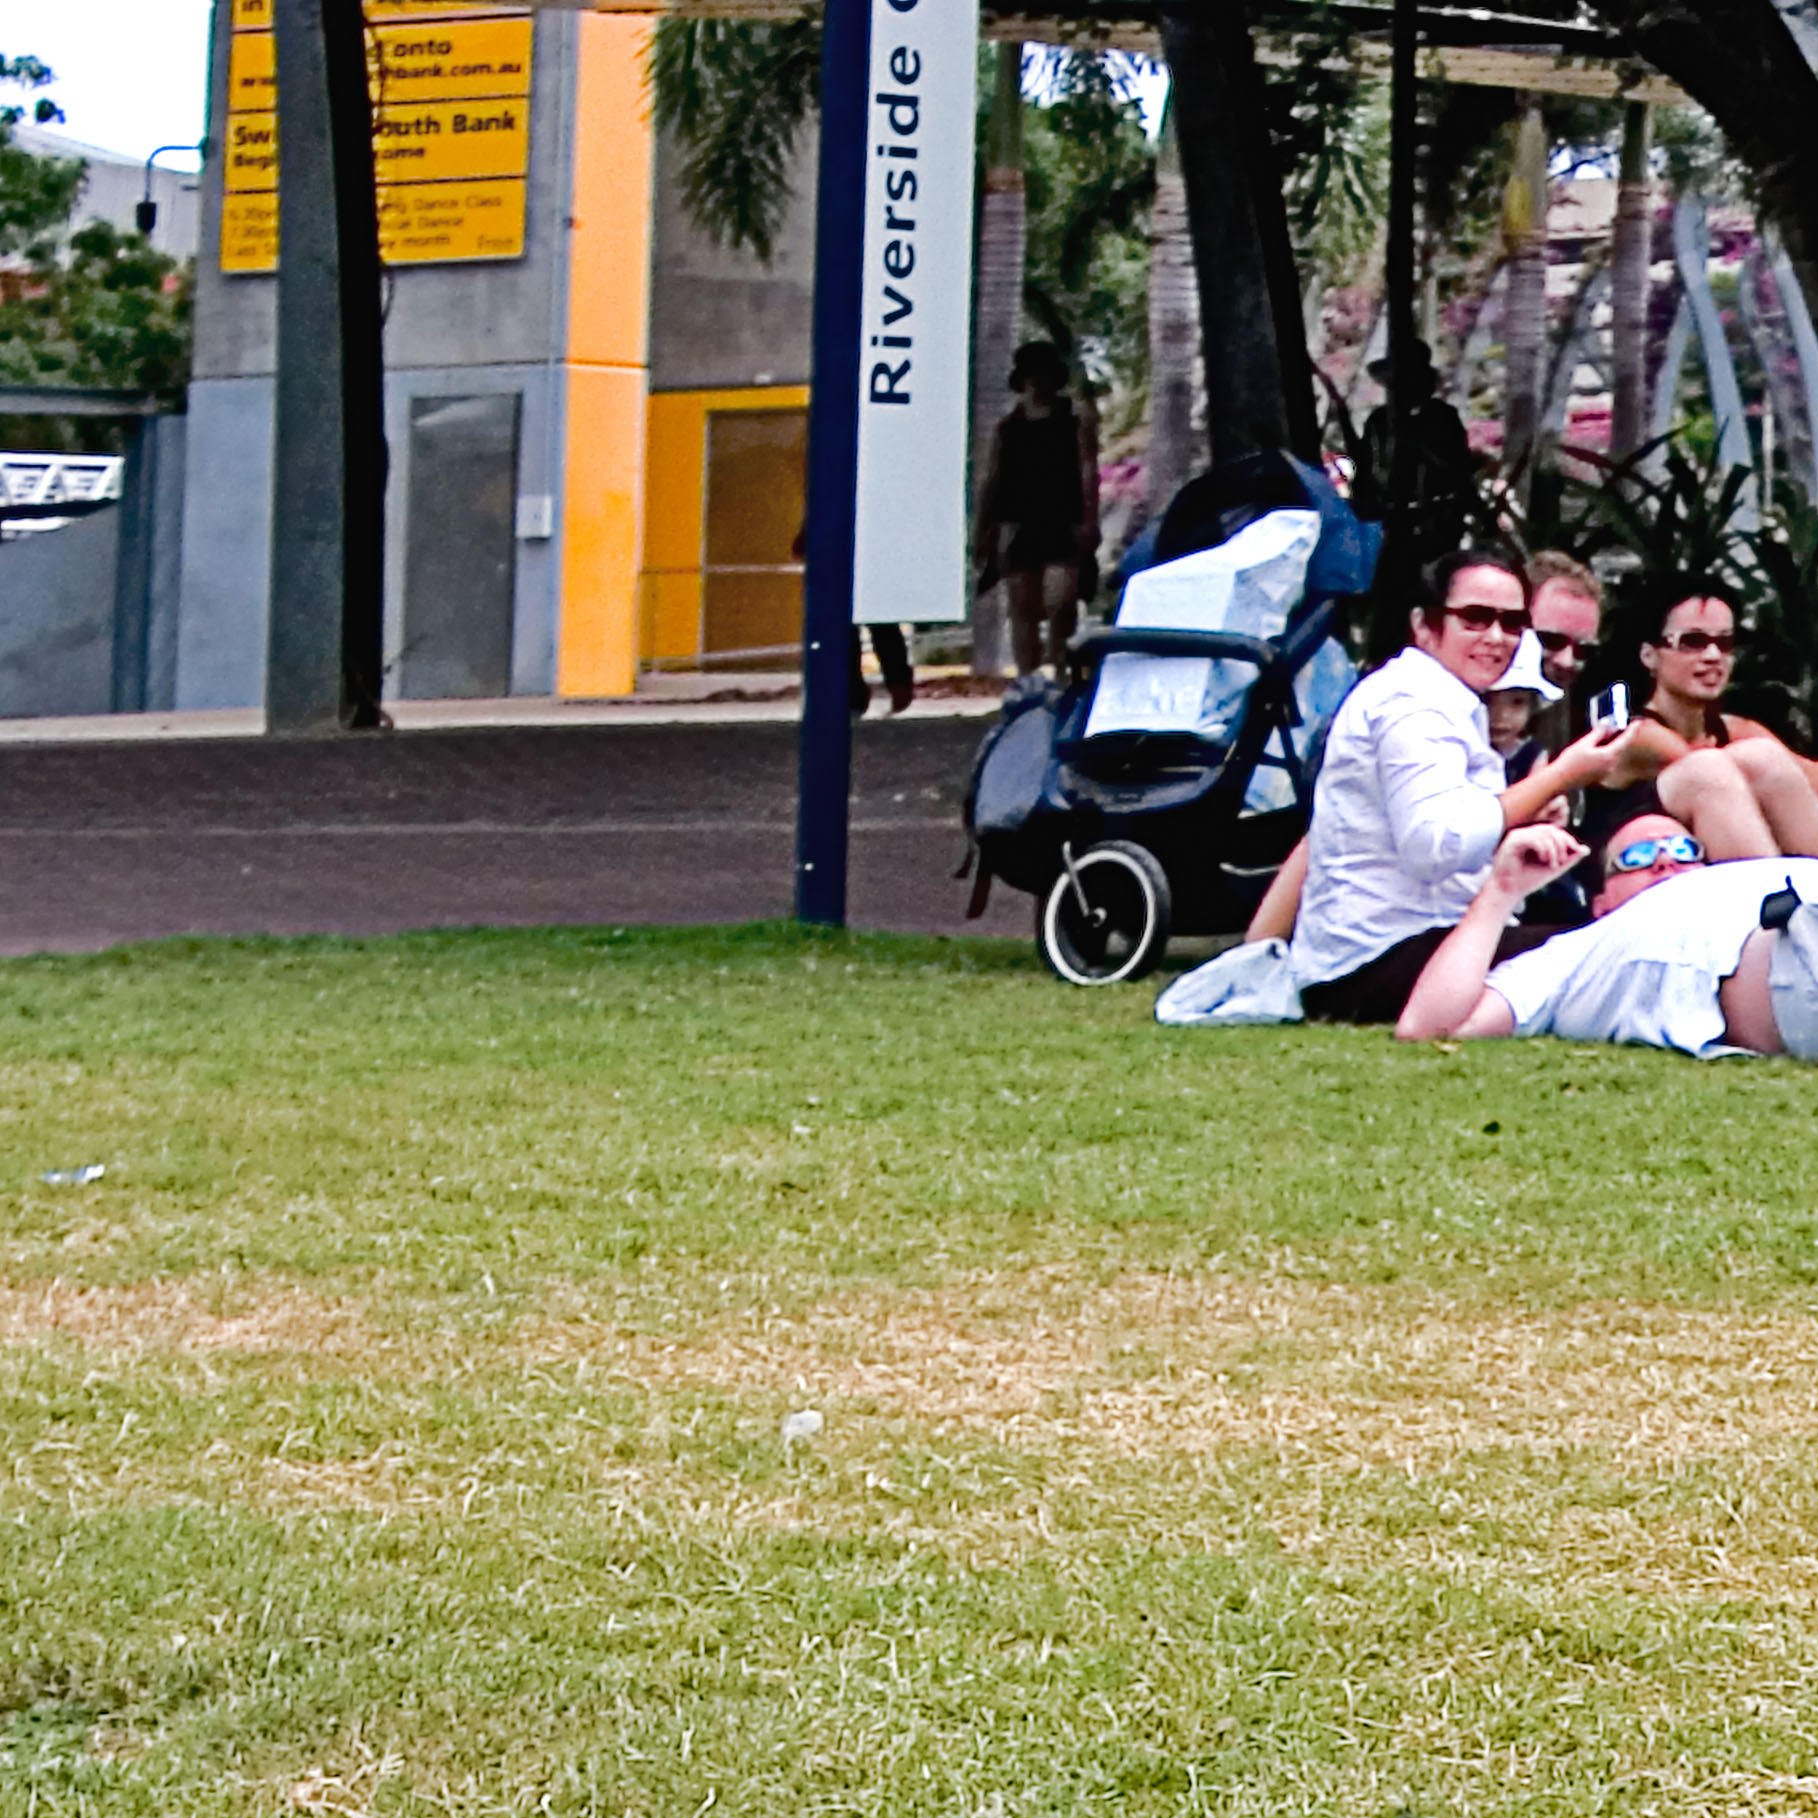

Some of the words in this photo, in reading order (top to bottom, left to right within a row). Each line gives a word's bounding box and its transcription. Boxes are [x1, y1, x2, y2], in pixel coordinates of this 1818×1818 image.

[394, 40, 452, 57] onto
[453, 110, 516, 133] Bank
[868, 45, 921, 404] Riverside
